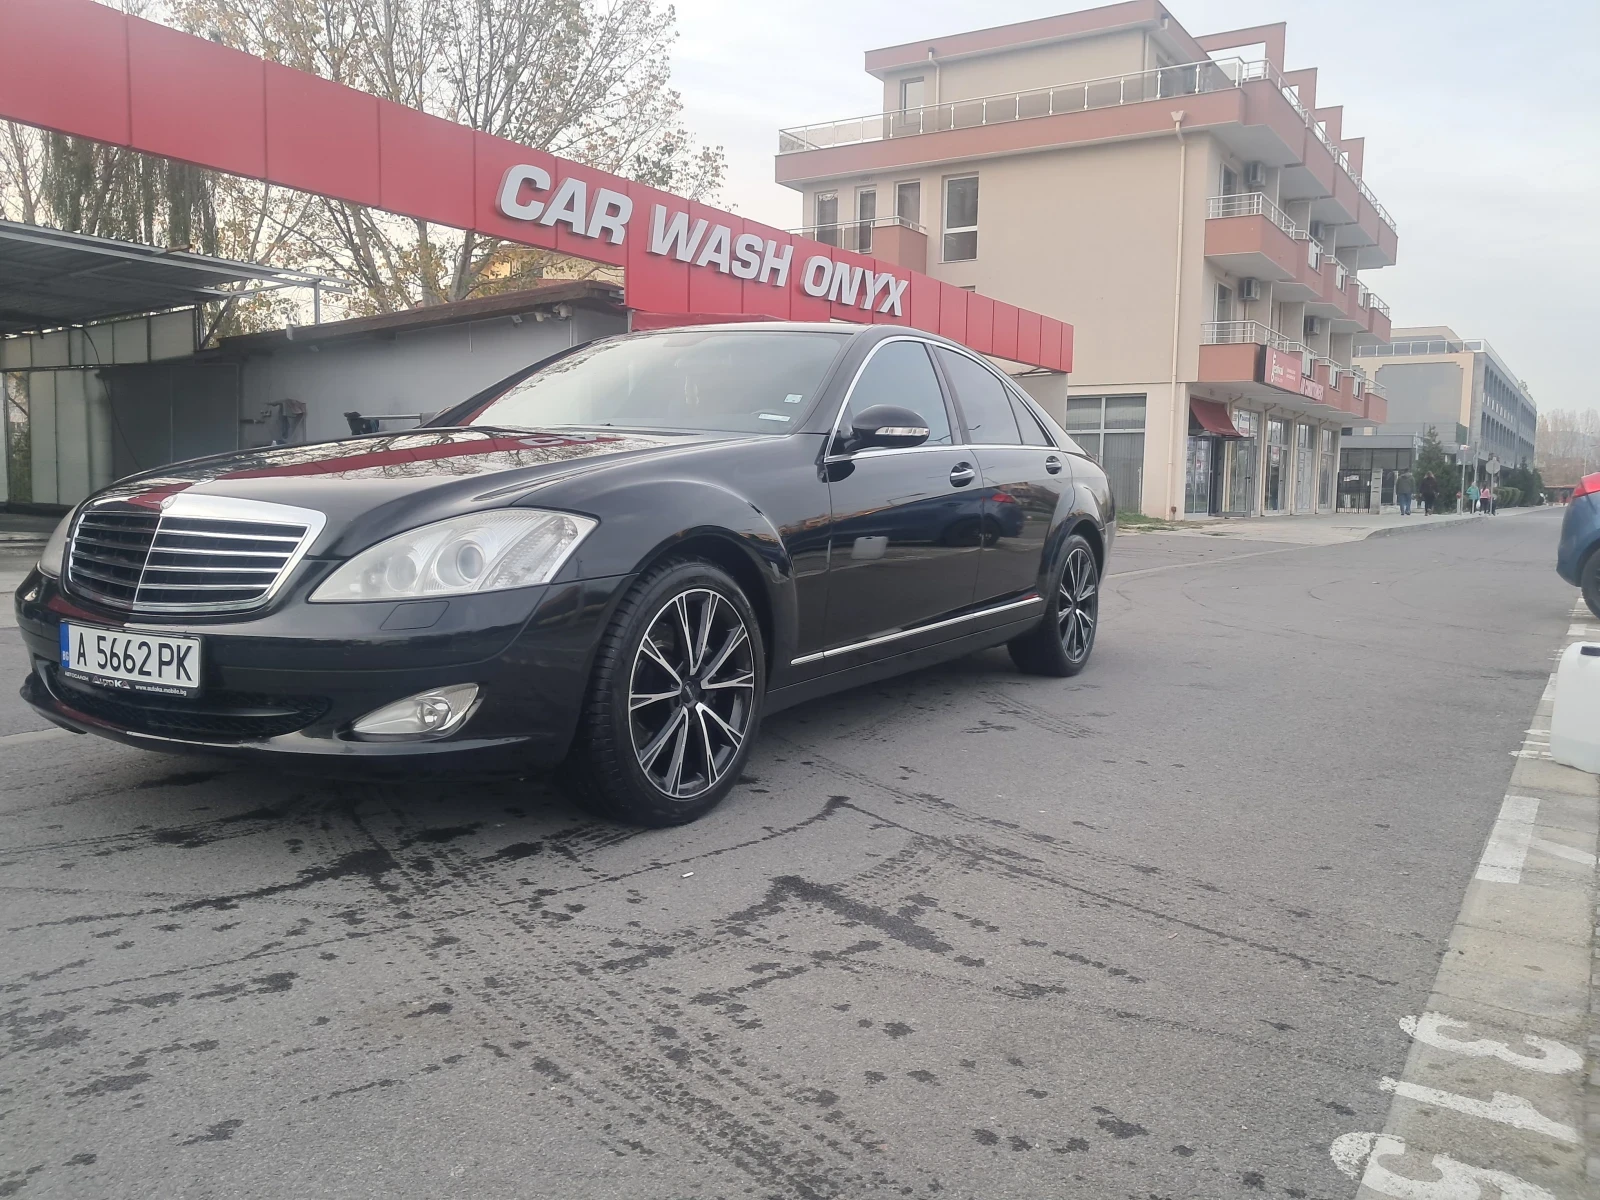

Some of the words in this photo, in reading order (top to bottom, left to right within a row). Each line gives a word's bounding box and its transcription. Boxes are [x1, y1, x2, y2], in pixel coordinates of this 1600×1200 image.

[496, 164, 633, 246] CAR
[646, 204, 794, 287] WASH
[801, 255, 908, 317] ONYX
[77, 632, 87, 666] A
